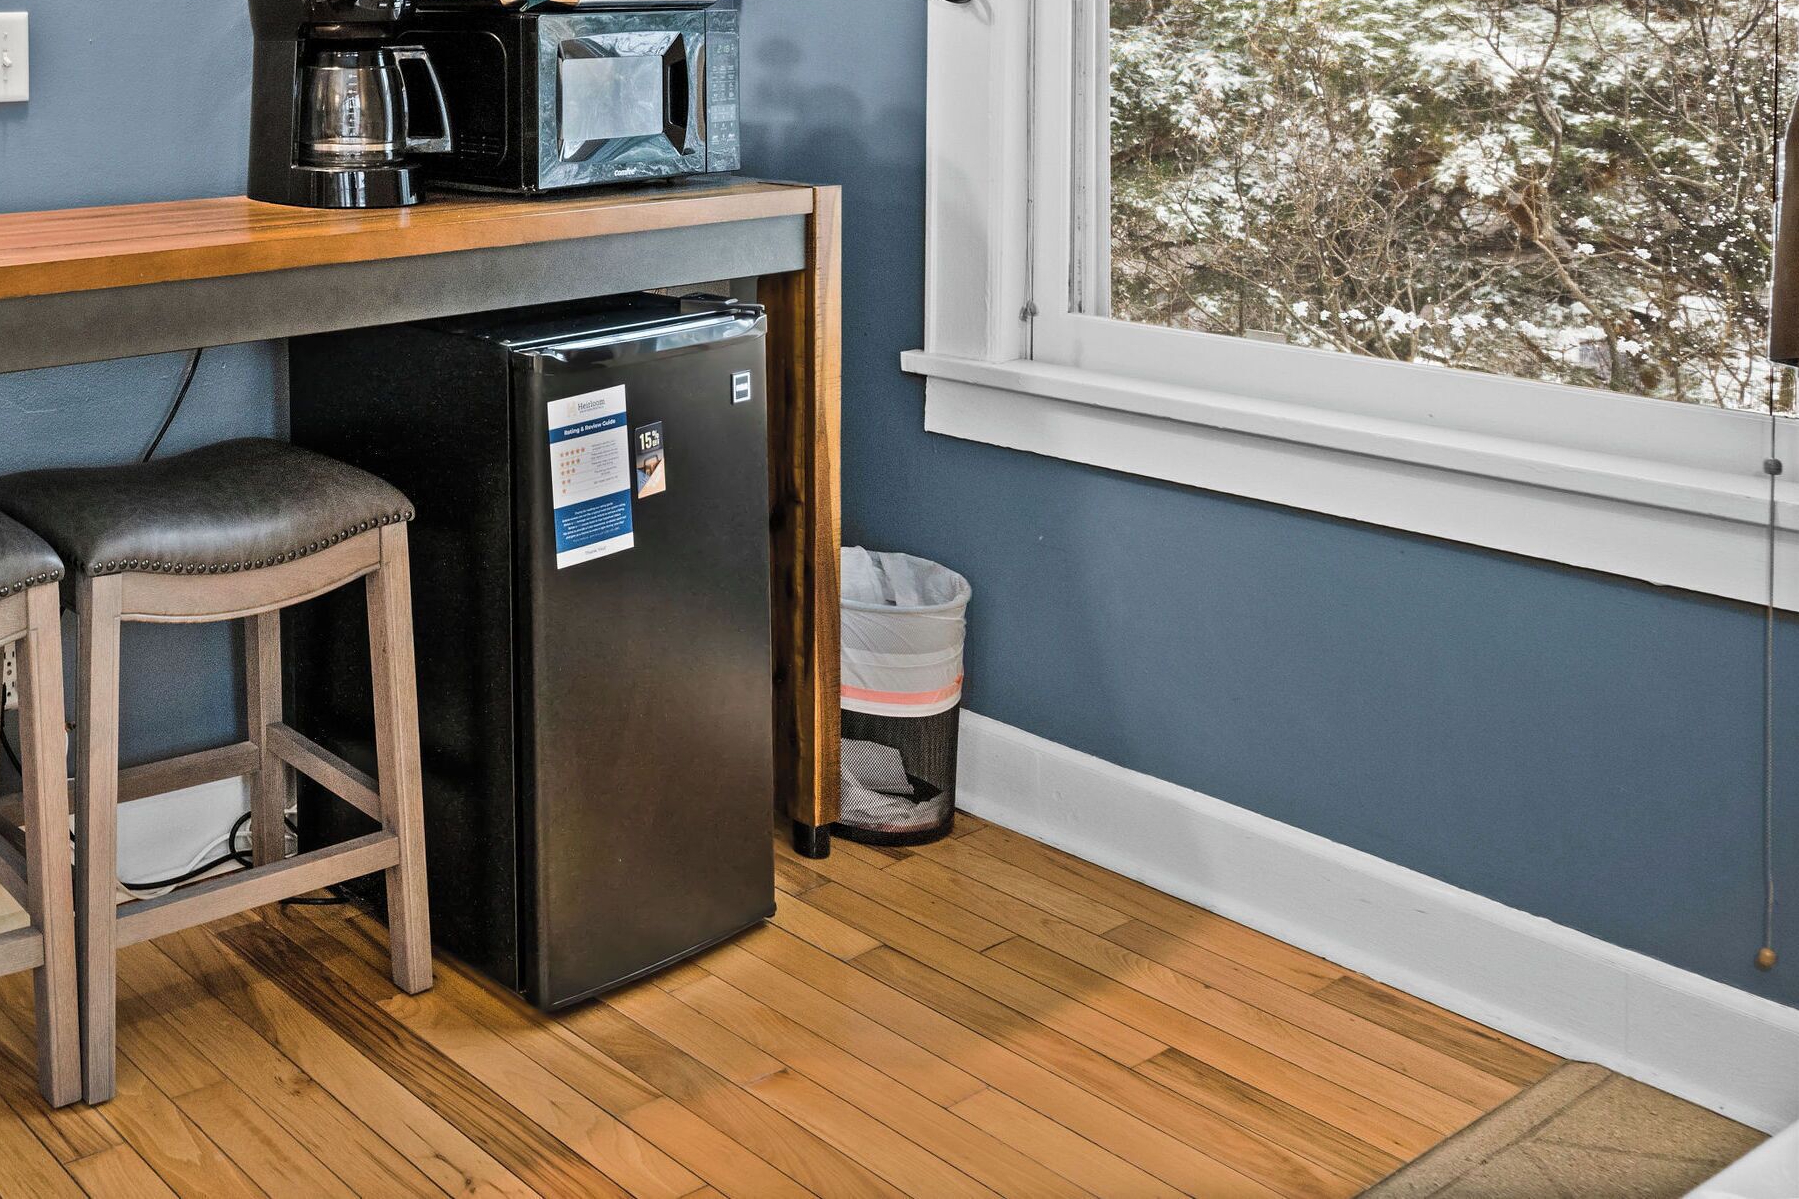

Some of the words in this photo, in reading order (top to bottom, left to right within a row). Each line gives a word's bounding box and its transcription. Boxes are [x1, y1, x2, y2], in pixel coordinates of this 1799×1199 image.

[577, 399, 606, 411] Heirloom
[564, 427, 580, 436] Rating
[584, 423, 602, 431] Review
[602, 418, 616, 426] Guide
[639, 429, 660, 450] 15%
